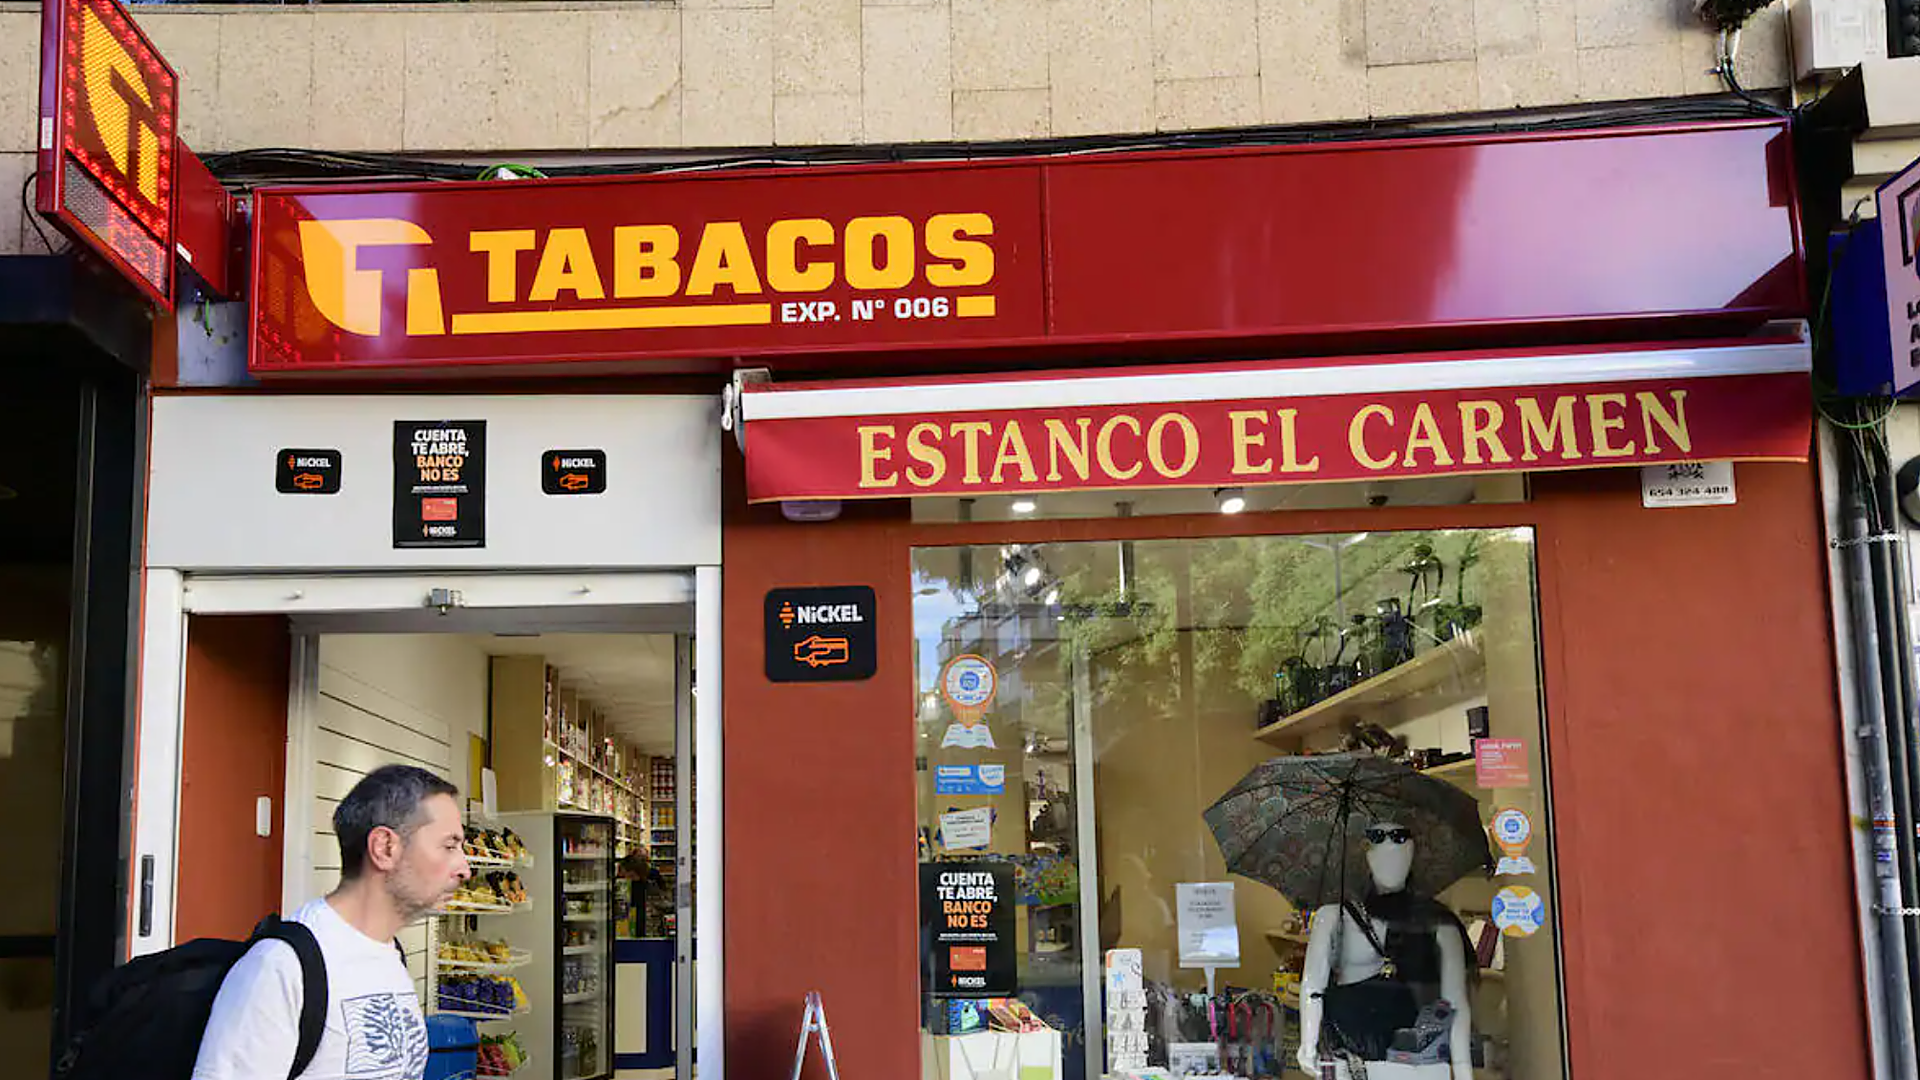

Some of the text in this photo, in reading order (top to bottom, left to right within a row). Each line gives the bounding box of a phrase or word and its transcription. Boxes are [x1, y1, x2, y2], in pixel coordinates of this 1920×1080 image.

[469, 212, 995, 303] TABACOS
[780, 302, 842, 324] EXP.
[894, 297, 950, 319] 006
[414, 428, 468, 442] CUENTA
[857, 389, 1694, 489] ESTANCO EL CARMEN
[411, 442, 470, 457] TE ABRE,
[416, 455, 464, 468] BANCO
[420, 469, 460, 482] NO ES
[939, 872, 995, 886] CUENTA
[936, 886, 998, 902] TE ABRE,
[943, 901, 992, 915] BANCO
[947, 915, 988, 928] NO ES
